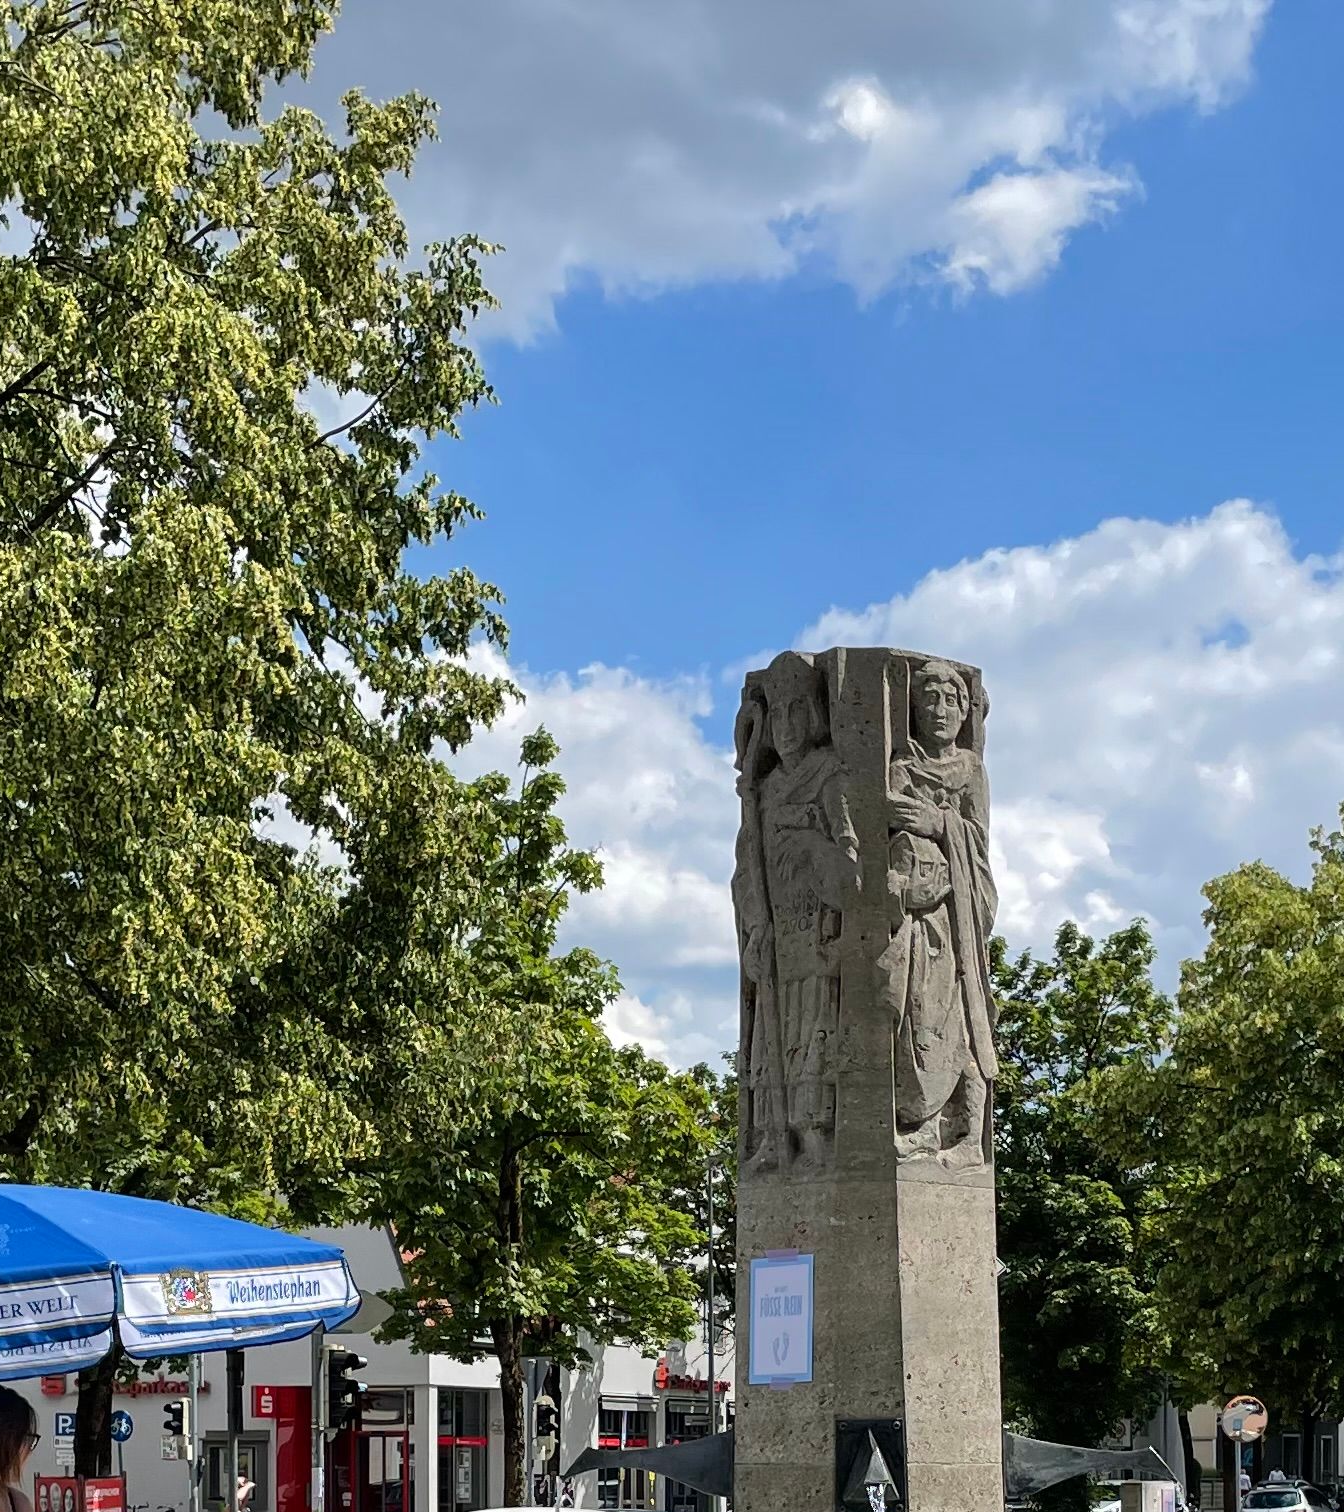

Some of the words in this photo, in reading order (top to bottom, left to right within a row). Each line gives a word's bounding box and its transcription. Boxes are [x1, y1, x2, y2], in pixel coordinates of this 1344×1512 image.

[227, 1275, 321, 1304] Weihenstephan
[26, 1295, 78, 1316] WELT
[59, 1415, 72, 1434] P
